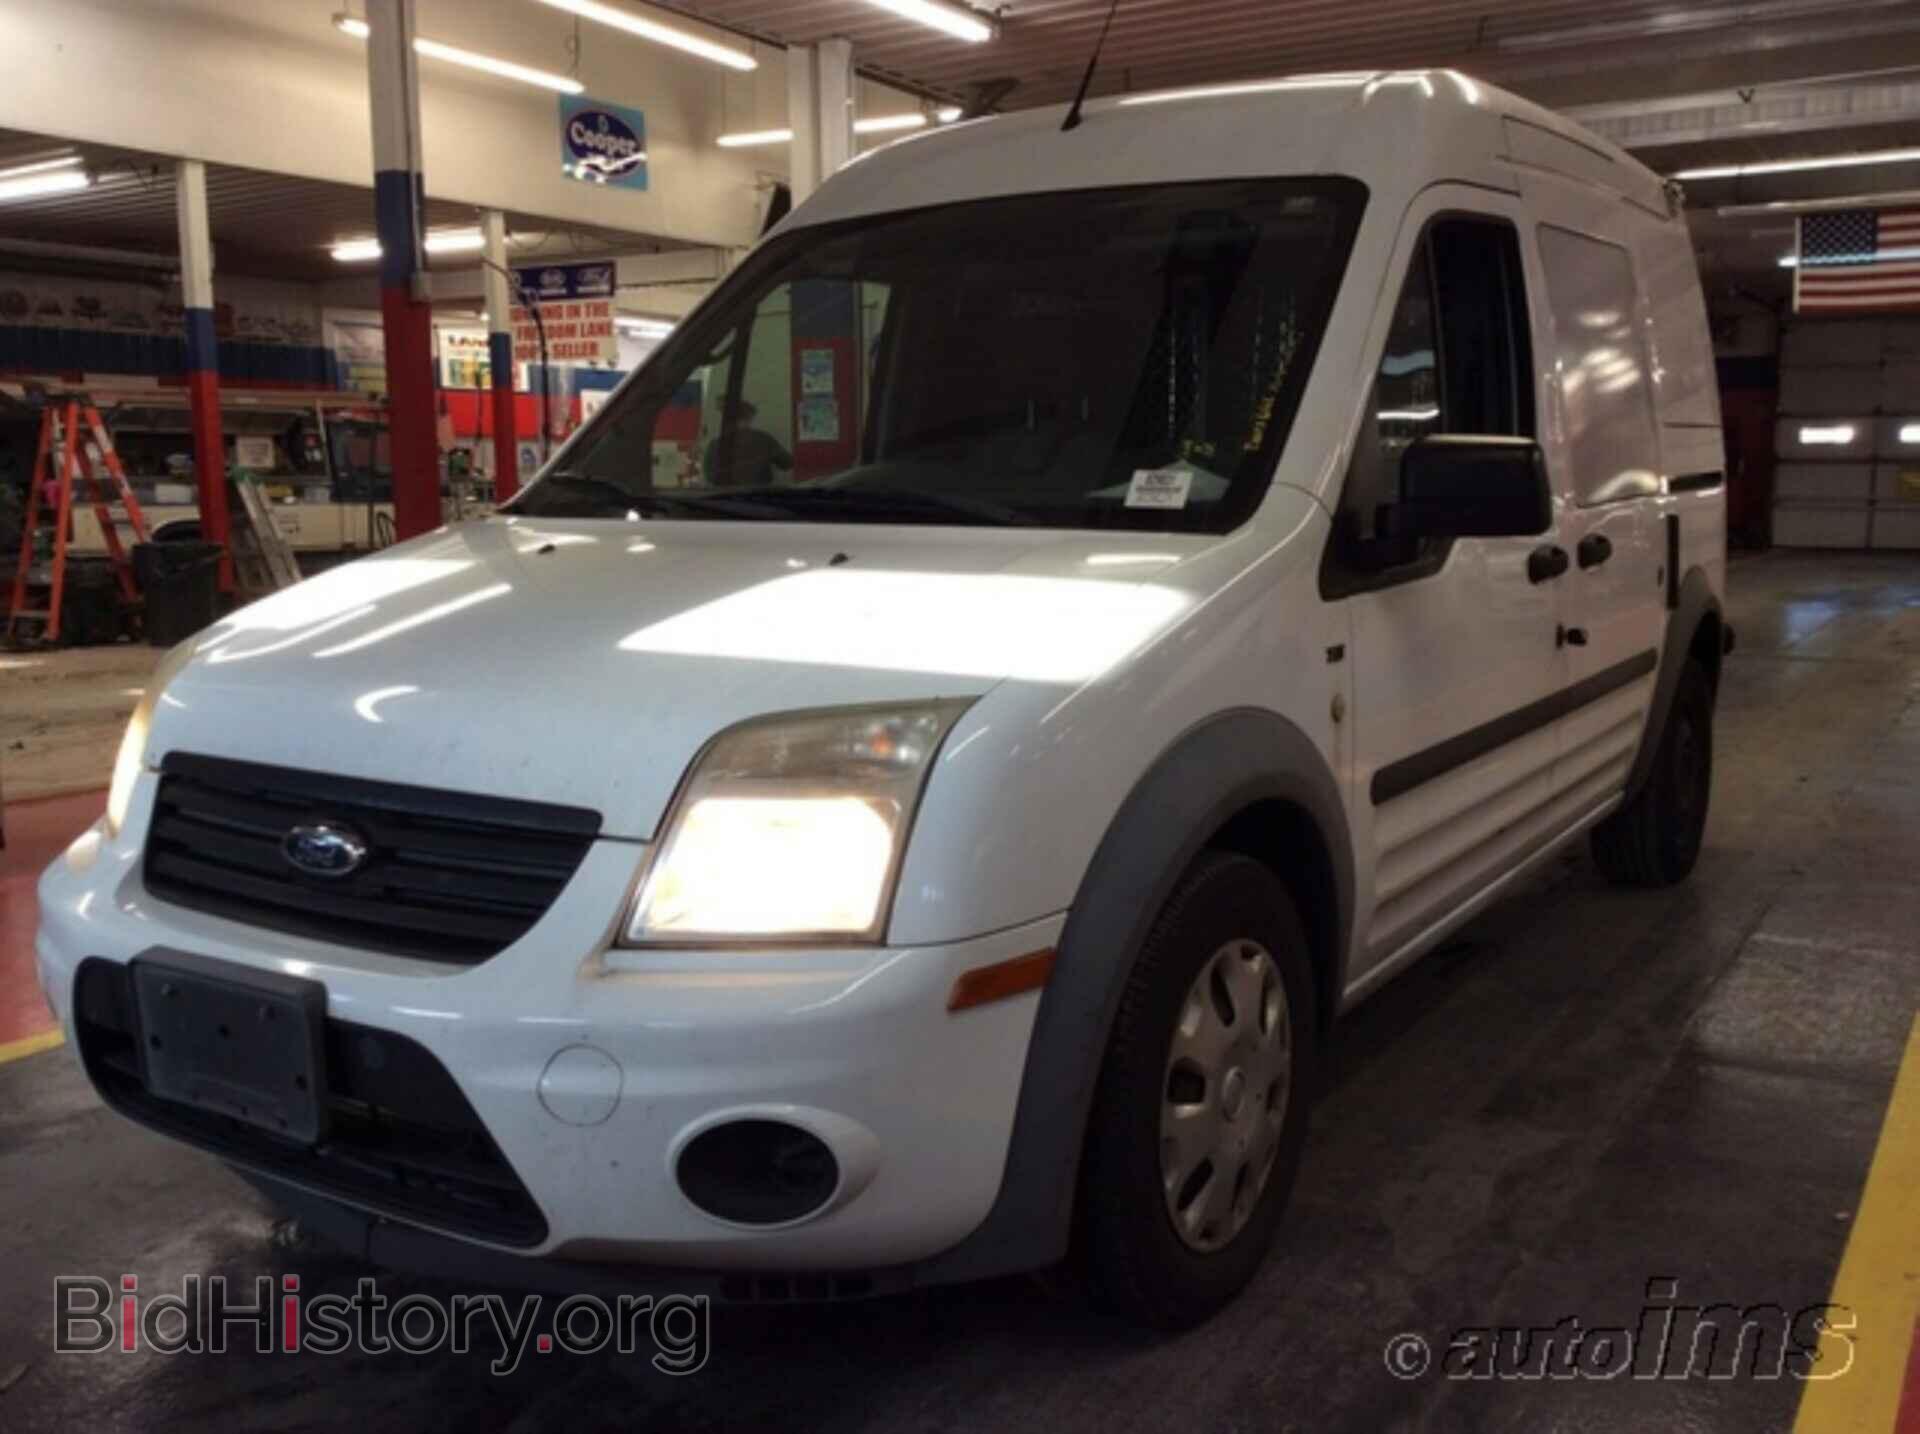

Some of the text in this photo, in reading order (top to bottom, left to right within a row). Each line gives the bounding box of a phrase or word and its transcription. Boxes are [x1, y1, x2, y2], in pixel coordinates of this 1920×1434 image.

[571, 122, 637, 156] Cooper
[517, 323, 577, 342] FREDOM
[552, 340, 598, 359] SELLER
